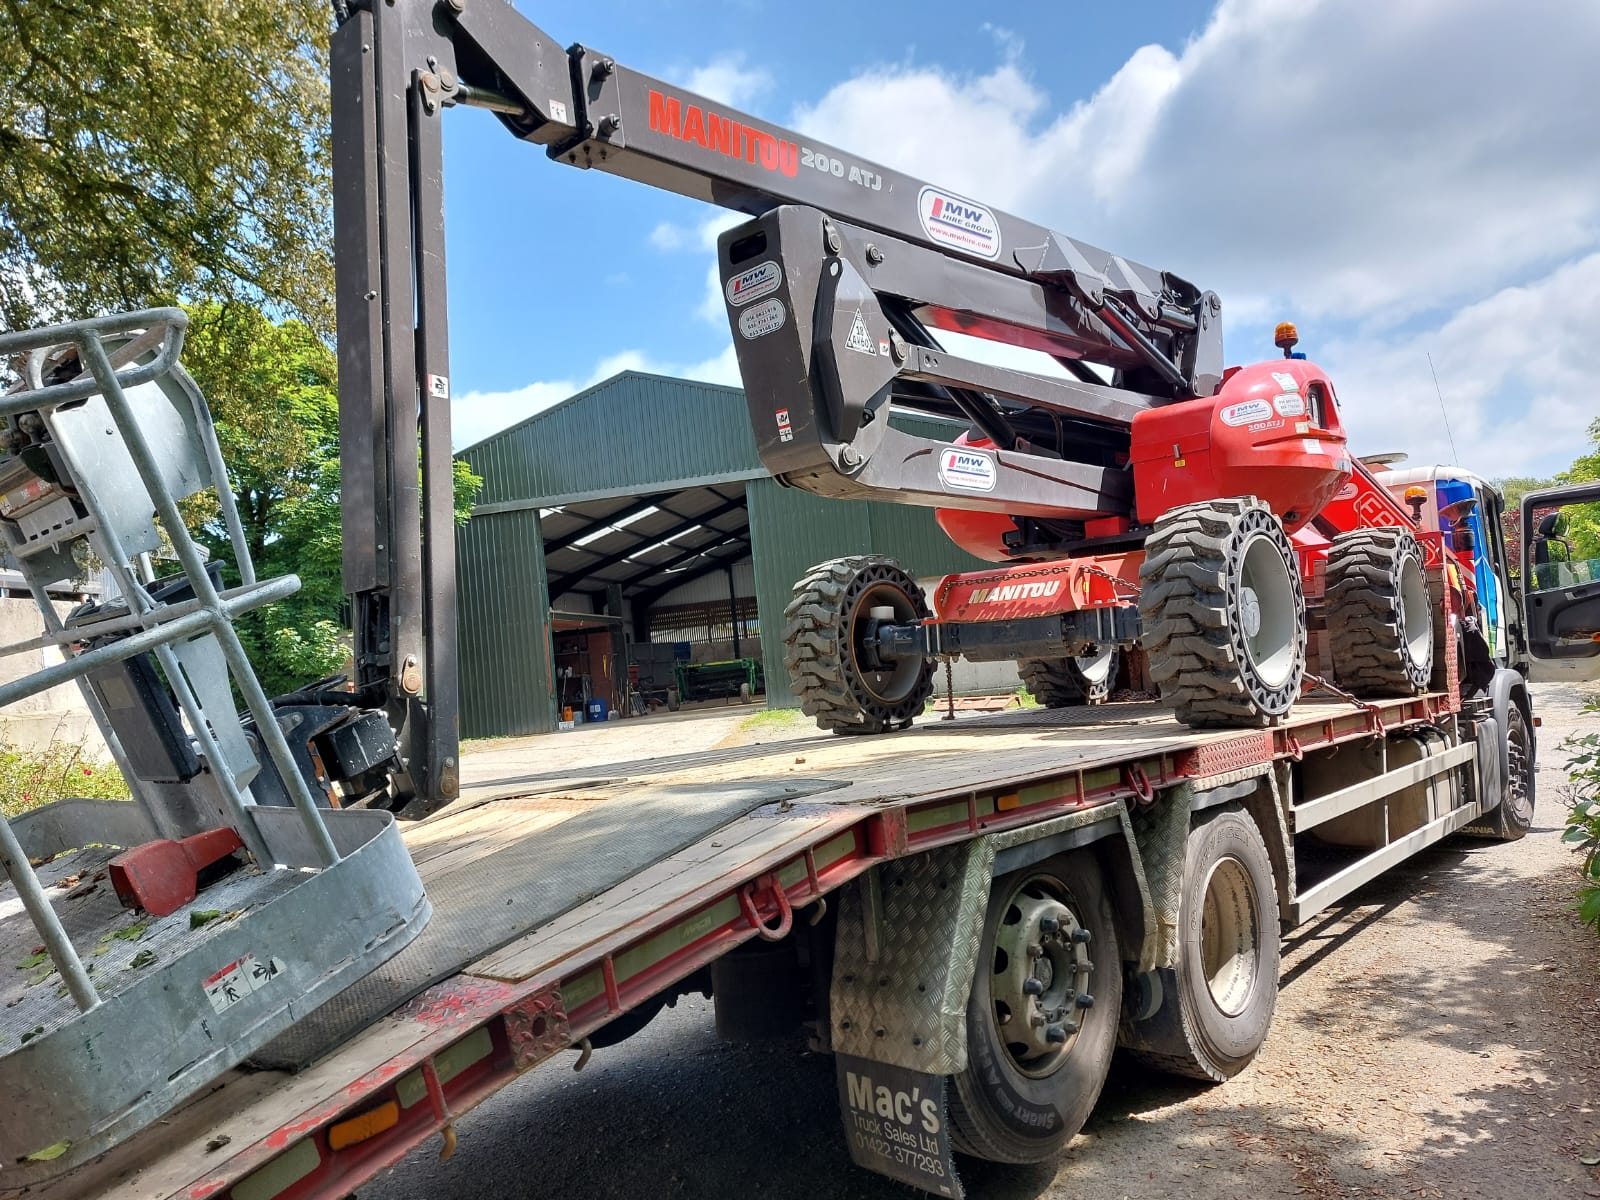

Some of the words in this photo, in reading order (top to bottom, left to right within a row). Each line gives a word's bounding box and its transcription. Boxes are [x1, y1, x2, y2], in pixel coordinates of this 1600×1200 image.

[649, 89, 799, 178] MANITOU
[801, 147, 844, 178] 200
[848, 166, 882, 192] ATJ
[945, 202, 982, 222] MW
[943, 214, 963, 224] HIRE
[965, 222, 993, 235] GROUP
[742, 268, 767, 284] MW
[958, 456, 984, 467] MW
[968, 580, 1061, 604] MANITOU
[846, 1071, 940, 1134] Mac's
[851, 1110, 882, 1137] Truck
[884, 1121, 917, 1149] Sales
[919, 1134, 939, 1155] Ltd
[855, 1131, 893, 1160] 01422
[895, 1146, 945, 1177] 377293
